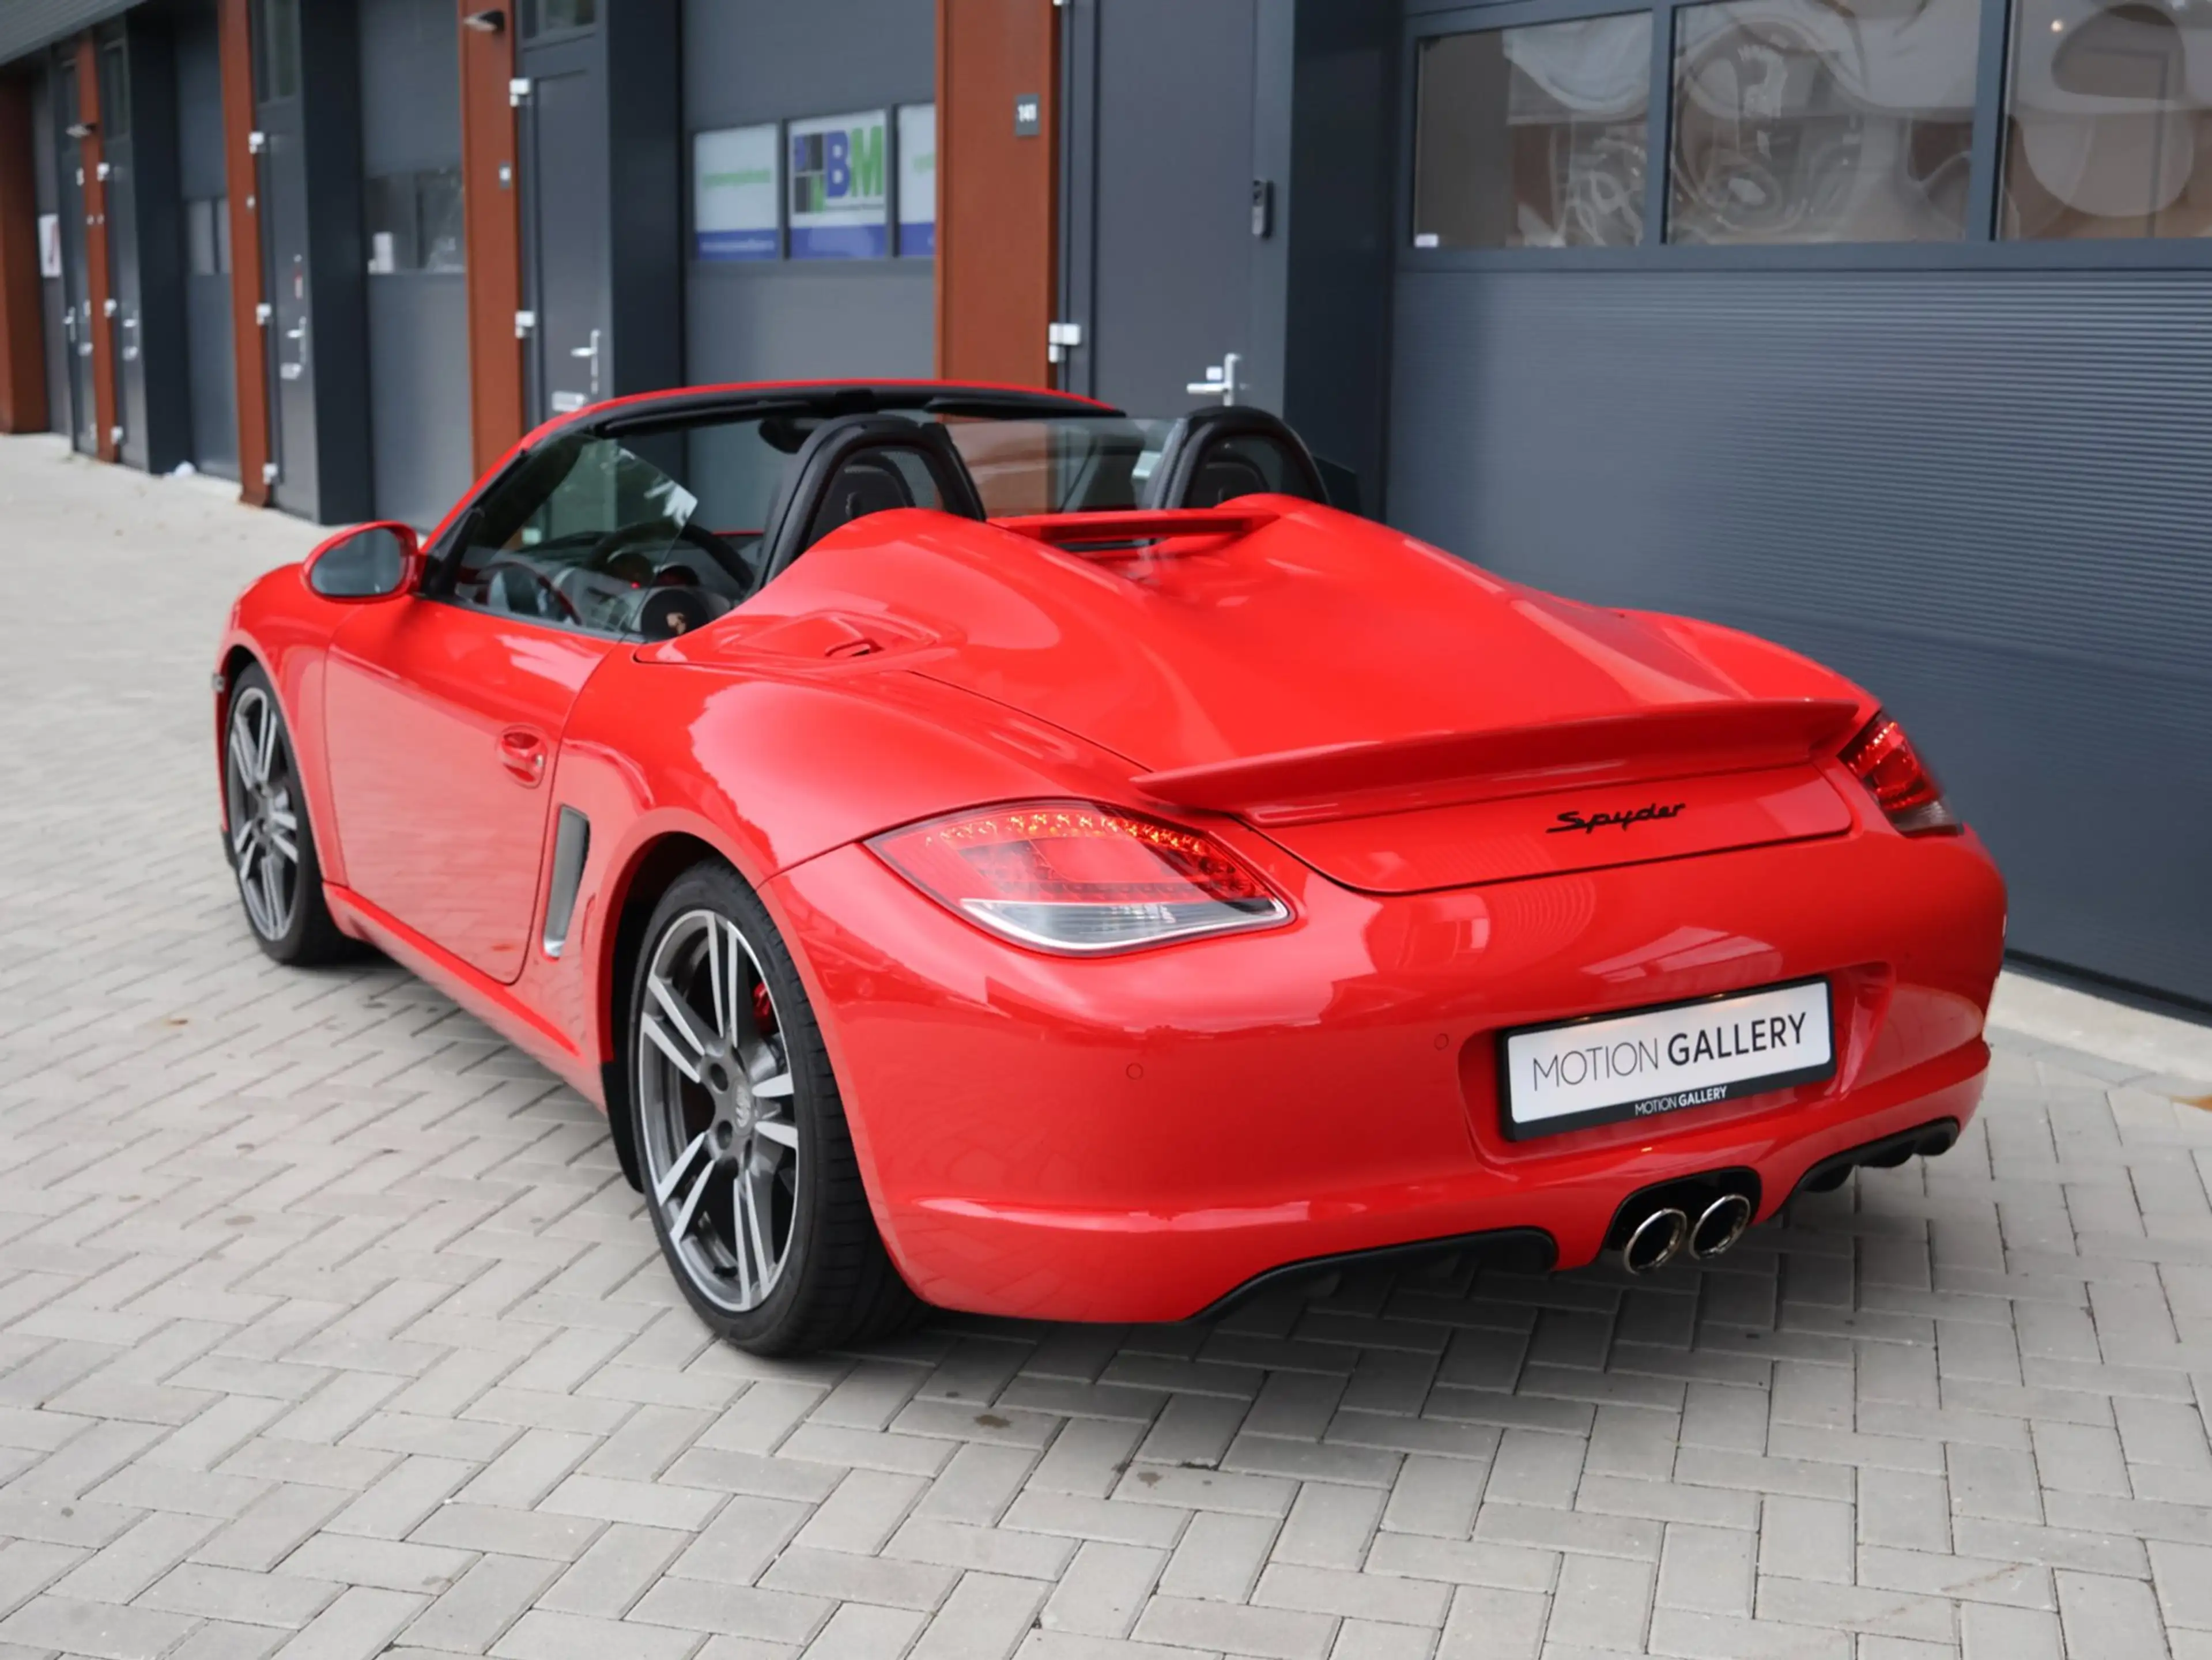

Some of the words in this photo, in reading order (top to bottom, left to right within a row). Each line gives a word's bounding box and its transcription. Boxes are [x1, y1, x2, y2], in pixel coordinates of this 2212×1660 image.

[1546, 803, 1686, 834] Spyder
[1533, 1038, 1659, 1092] MOTION
[1667, 1012, 1807, 1067] GALLERY
[1635, 1096, 1678, 1116] MOTION
[1678, 1085, 1728, 1107] GALLERY
